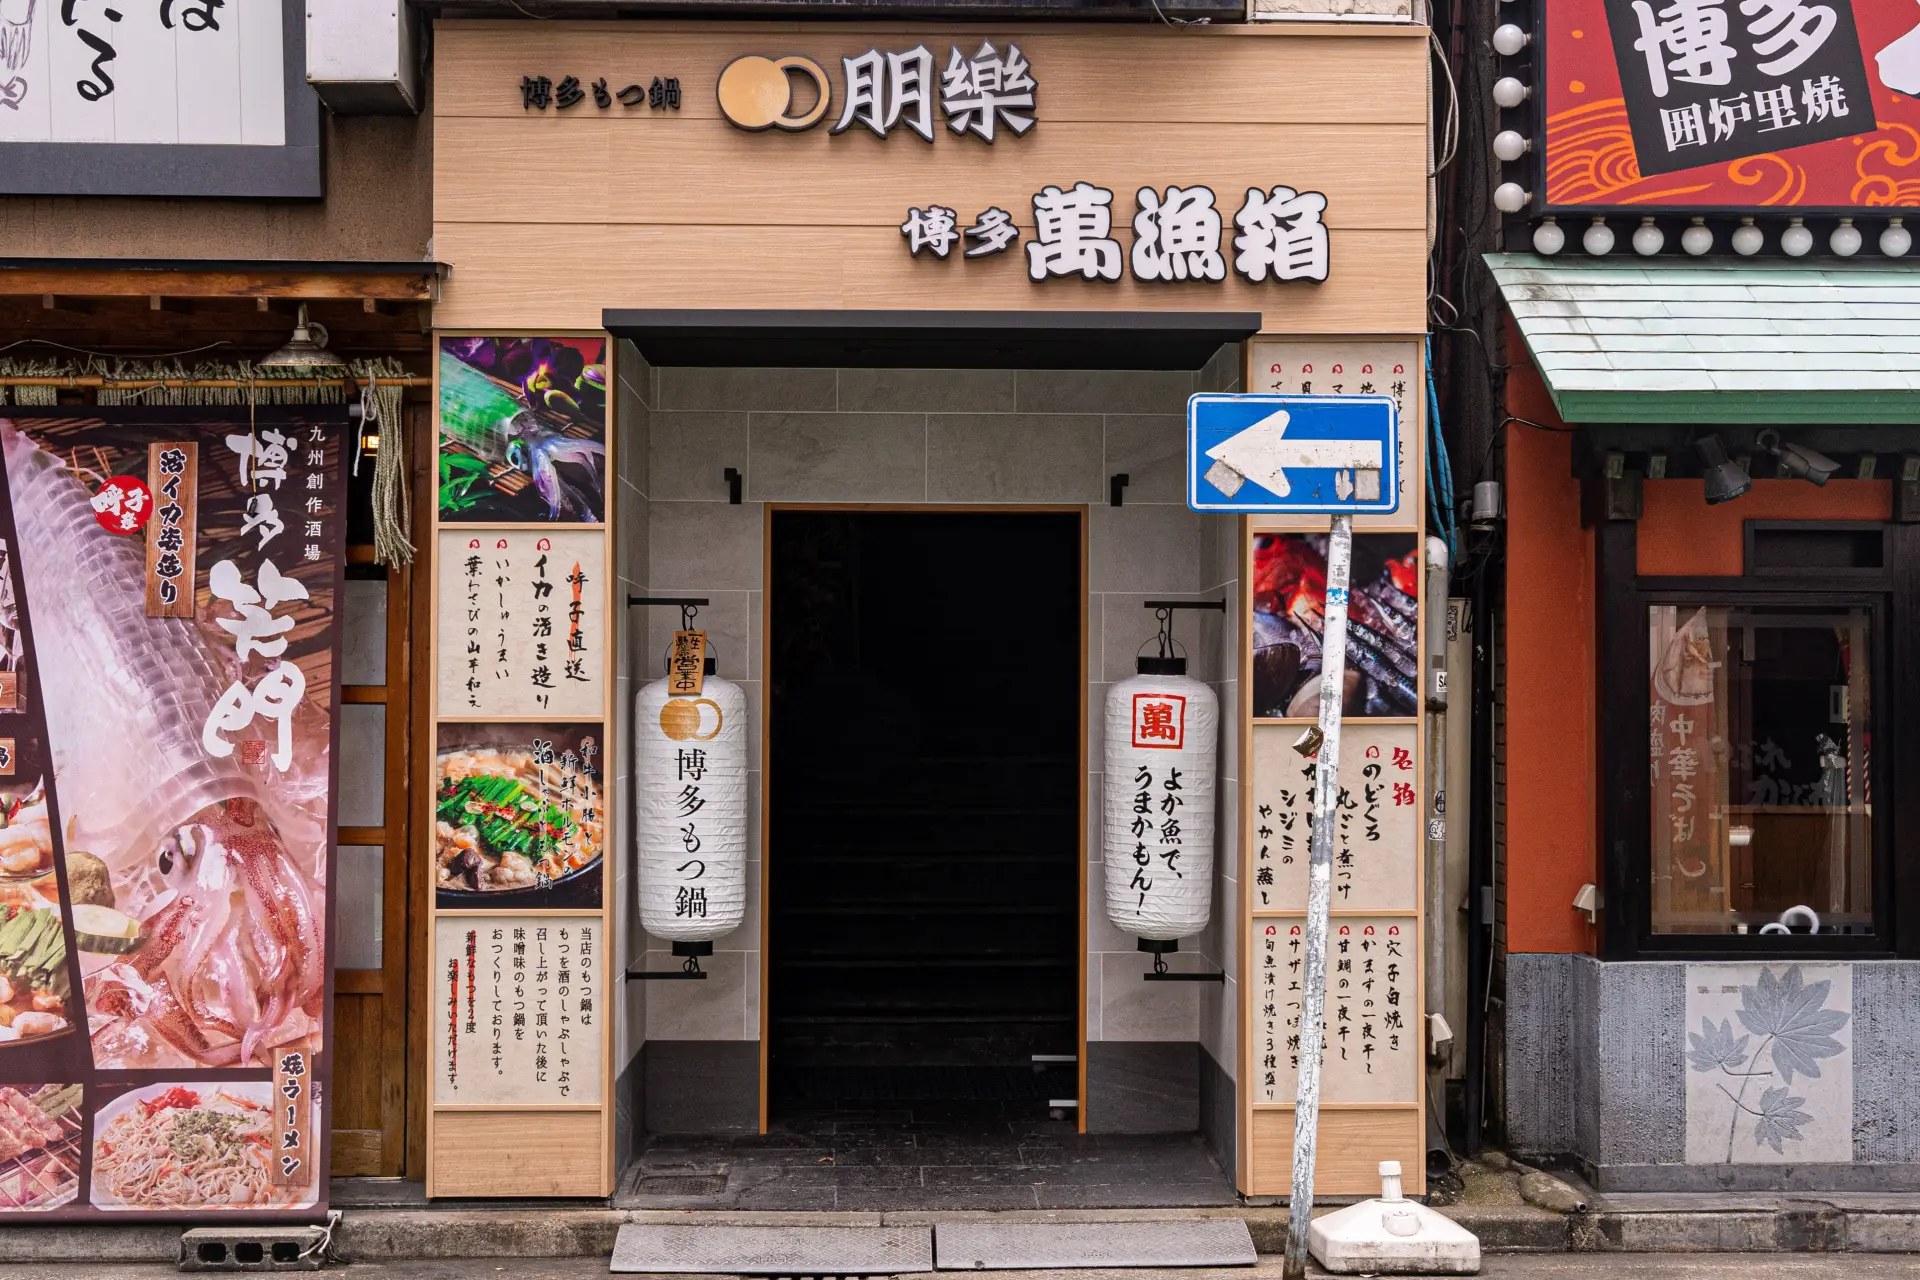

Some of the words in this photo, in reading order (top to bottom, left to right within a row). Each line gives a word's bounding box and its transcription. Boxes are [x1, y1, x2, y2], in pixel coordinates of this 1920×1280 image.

[519, 74, 683, 111] 博多もつ鍋
[827, 39, 1039, 144] 朋樂
[1632, 0, 1837, 97] 博多
[1659, 75, 1850, 153] 囲炉里焼
[900, 204, 1020, 262] 博多
[1025, 181, 1330, 286] 萬漁箱
[90, 483, 149, 516] 呼子
[155, 447, 187, 606] 活イカ姿造り
[225, 427, 299, 551] 博多
[304, 425, 327, 561] 九州創作酒場
[203, 557, 310, 773] 笑門
[464, 555, 483, 708] 葉わさびの山芋和え
[495, 558, 510, 680] いかしゅうまい
[531, 554, 556, 710] イカの活き造り
[564, 571, 591, 682] 呼子直送
[1139, 702, 1176, 742] 萬
[1392, 747, 1416, 807] 名物
[559, 752, 578, 875] 新鮮ホルモンの
[580, 741, 598, 846] 和牛小腸と
[673, 748, 708, 919] 博多もつ鍋
[1129, 765, 1154, 916] うまかもん！
[1159, 767, 1184, 880] よか魚で、
[1278, 789, 1298, 865] シジミの
[1335, 785, 1359, 900] 丸ごと煮つけ
[1362, 763, 1385, 842] のどぐろ
[1256, 804, 1274, 905] やかん蒸し
[447, 958, 459, 1091] お楽しみいただけます。
[465, 931, 477, 1034] 新鮮なもつを2度
[491, 928, 503, 1076] おつくりしております。
[513, 927, 526, 1041] 味噌味のもつ鍋を
[535, 927, 548, 1082] 召し上がって頂いた後に
[558, 927, 571, 1097] もつを酒のしゃぶしゃぶで
[579, 927, 593, 1026] 当店のもつ鍋は
[1263, 938, 1277, 1101] 旬魚漬け焼き3種盛り
[1286, 938, 1302, 1070] サザエつぼ焼き
[1336, 938, 1352, 1061] 甘鯛の一夜干し
[1361, 939, 1377, 1075] かますの一夜干し
[1384, 939, 1404, 1051] 穴子白焼き
[279, 1051, 306, 1177] 焼ラーメン
